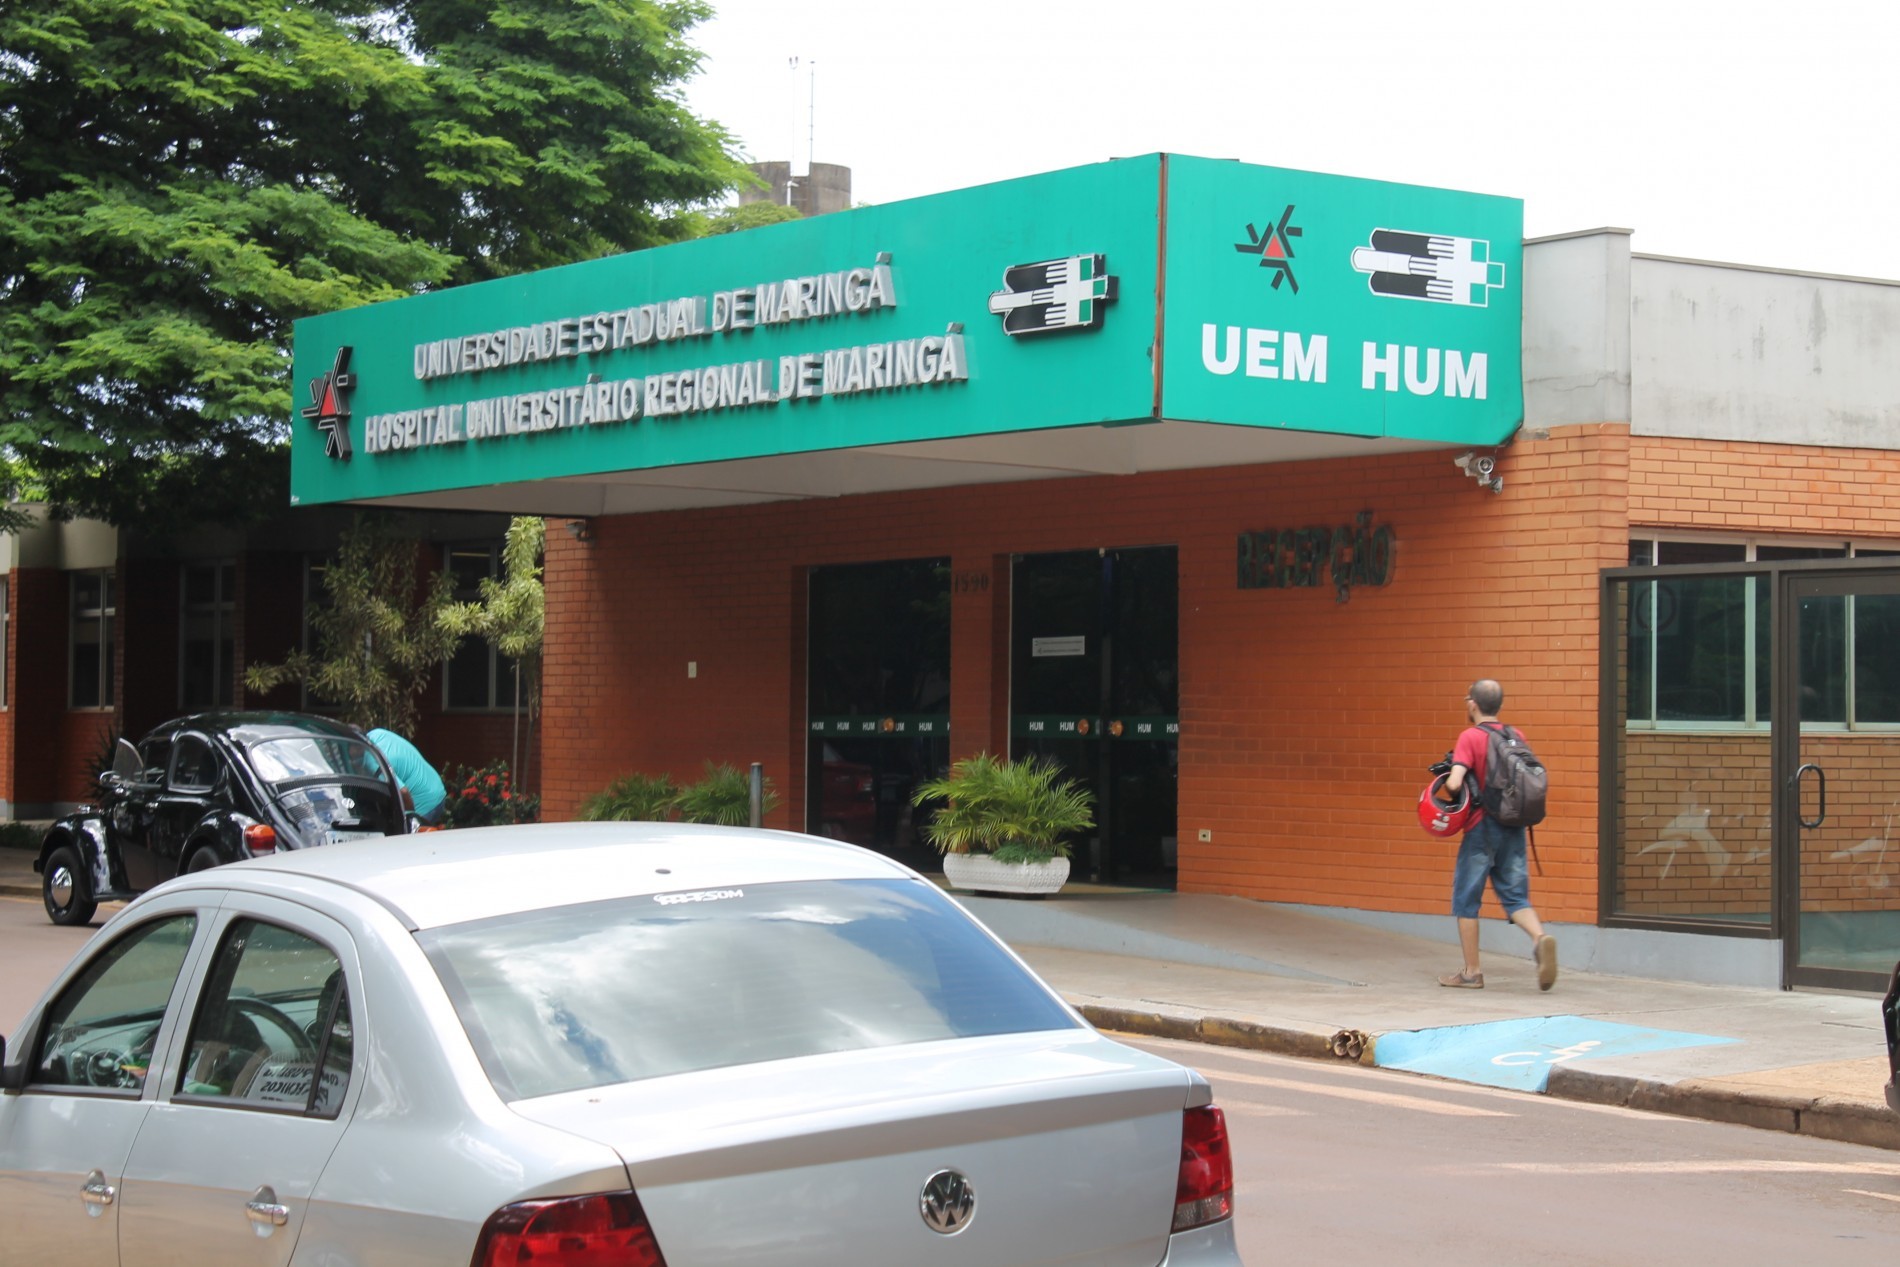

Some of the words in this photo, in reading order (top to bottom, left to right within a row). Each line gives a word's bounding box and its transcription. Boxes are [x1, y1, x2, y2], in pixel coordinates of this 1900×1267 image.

[414, 318, 575, 380] UNIVERSIDADE
[578, 296, 709, 353] ESTADUAL
[713, 288, 752, 331] DE
[755, 252, 895, 325] MARINGÁ
[365, 405, 465, 453] HOSPITAL
[466, 374, 641, 440] UNIVERSITÁRIO
[644, 360, 776, 417] REGIONAL
[779, 353, 820, 399] DE
[822, 322, 967, 395] MARINGÁ
[1202, 323, 1328, 384] UEM
[1361, 341, 1488, 400] HUM
[1237, 510, 1396, 604] RECEPÇÃO
[811, 721, 824, 731] HUM
[836, 721, 850, 731] HUM
[862, 721, 876, 731] HUM
[918, 721, 933, 731] HUM
[1029, 721, 1044, 731] HUM
[1059, 721, 1075, 731] HUM
[1137, 723, 1152, 733] HUM
